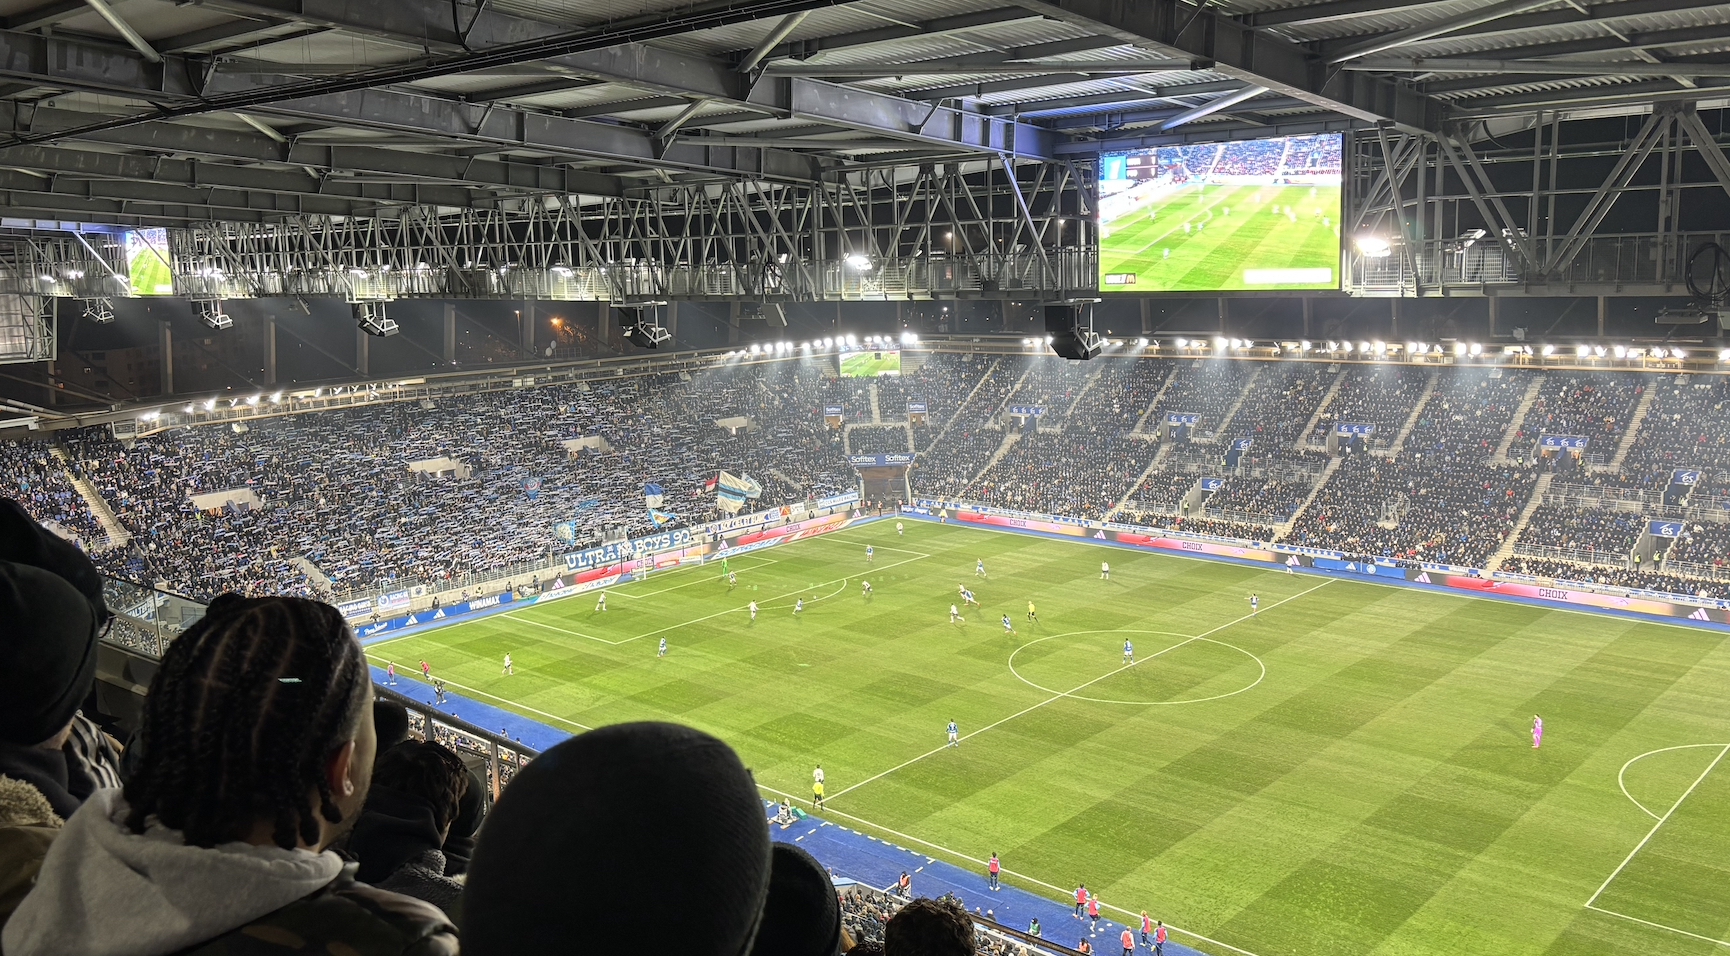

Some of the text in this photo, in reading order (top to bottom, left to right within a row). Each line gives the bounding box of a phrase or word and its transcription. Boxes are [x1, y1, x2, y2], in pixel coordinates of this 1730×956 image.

[885, 454, 910, 462] Sofitex
[634, 534, 671, 551] BOYS
[673, 529, 690, 545] 90
[1538, 588, 1569, 600] CHOIX
[469, 595, 500, 610] WINAMAX
